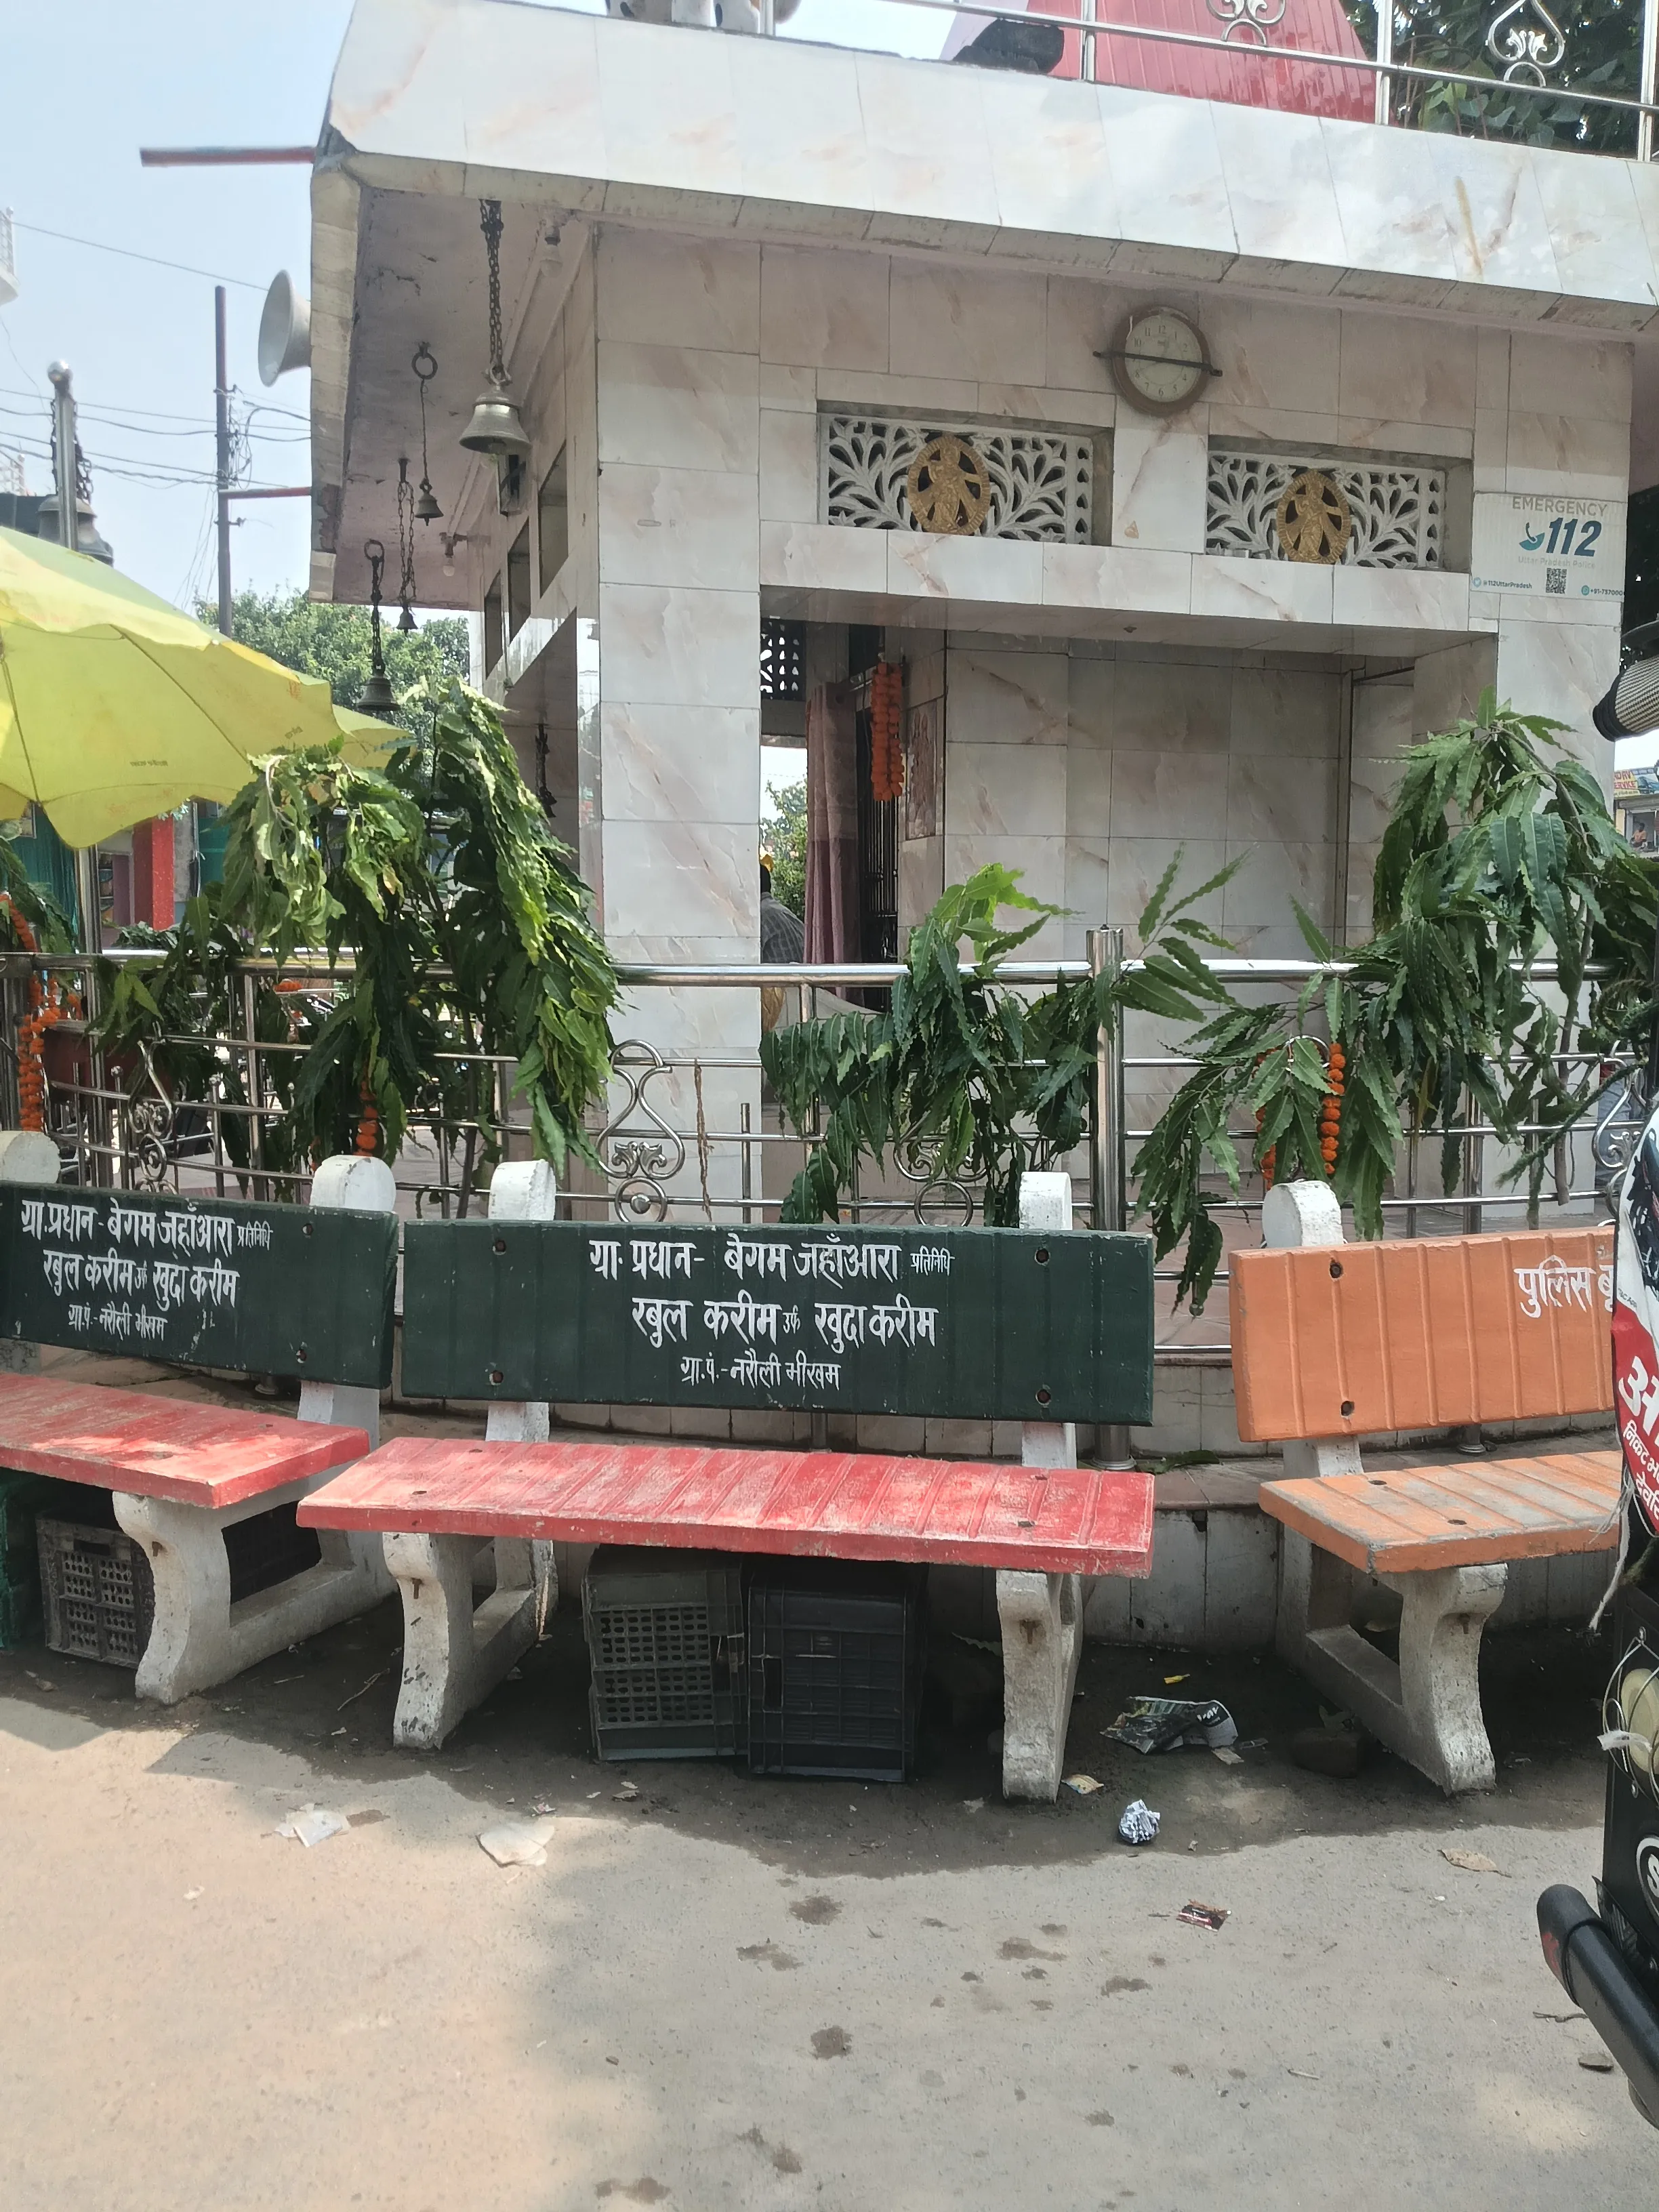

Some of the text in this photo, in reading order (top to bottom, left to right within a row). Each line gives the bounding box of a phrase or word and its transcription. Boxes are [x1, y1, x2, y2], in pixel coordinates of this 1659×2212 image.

[1512, 495, 1607, 517] EMERGENCY
[1546, 517, 1602, 557] 112
[107, 1197, 157, 1248] बेगम
[84, 1247, 136, 1296] करीम
[190, 1258, 241, 1308] करीम
[724, 1233, 793, 1282] बेगम
[1513, 1254, 1597, 1318] पुलिस
[632, 1297, 694, 1349] रबुल
[703, 1289, 782, 1345] करीम
[868, 1293, 939, 1347] करीम
[1623, 1419, 1650, 1465] निकट
